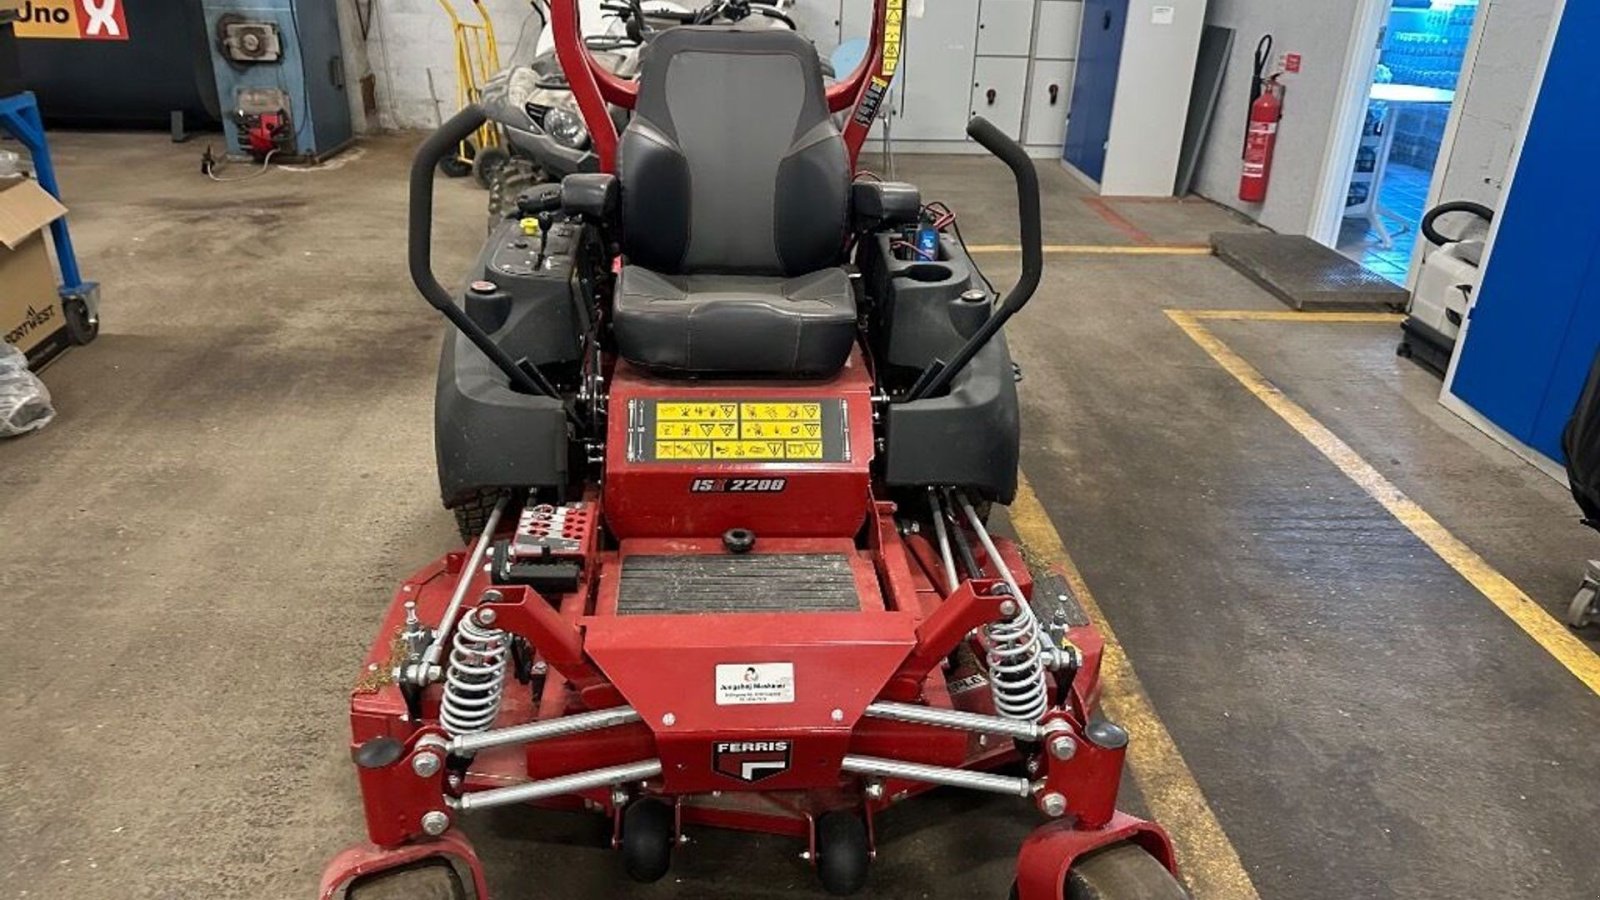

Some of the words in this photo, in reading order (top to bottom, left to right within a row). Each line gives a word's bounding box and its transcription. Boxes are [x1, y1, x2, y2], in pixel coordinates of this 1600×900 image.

[692, 479, 727, 491] ISX
[730, 479, 786, 491] 2200
[717, 742, 788, 752] FERRIS
